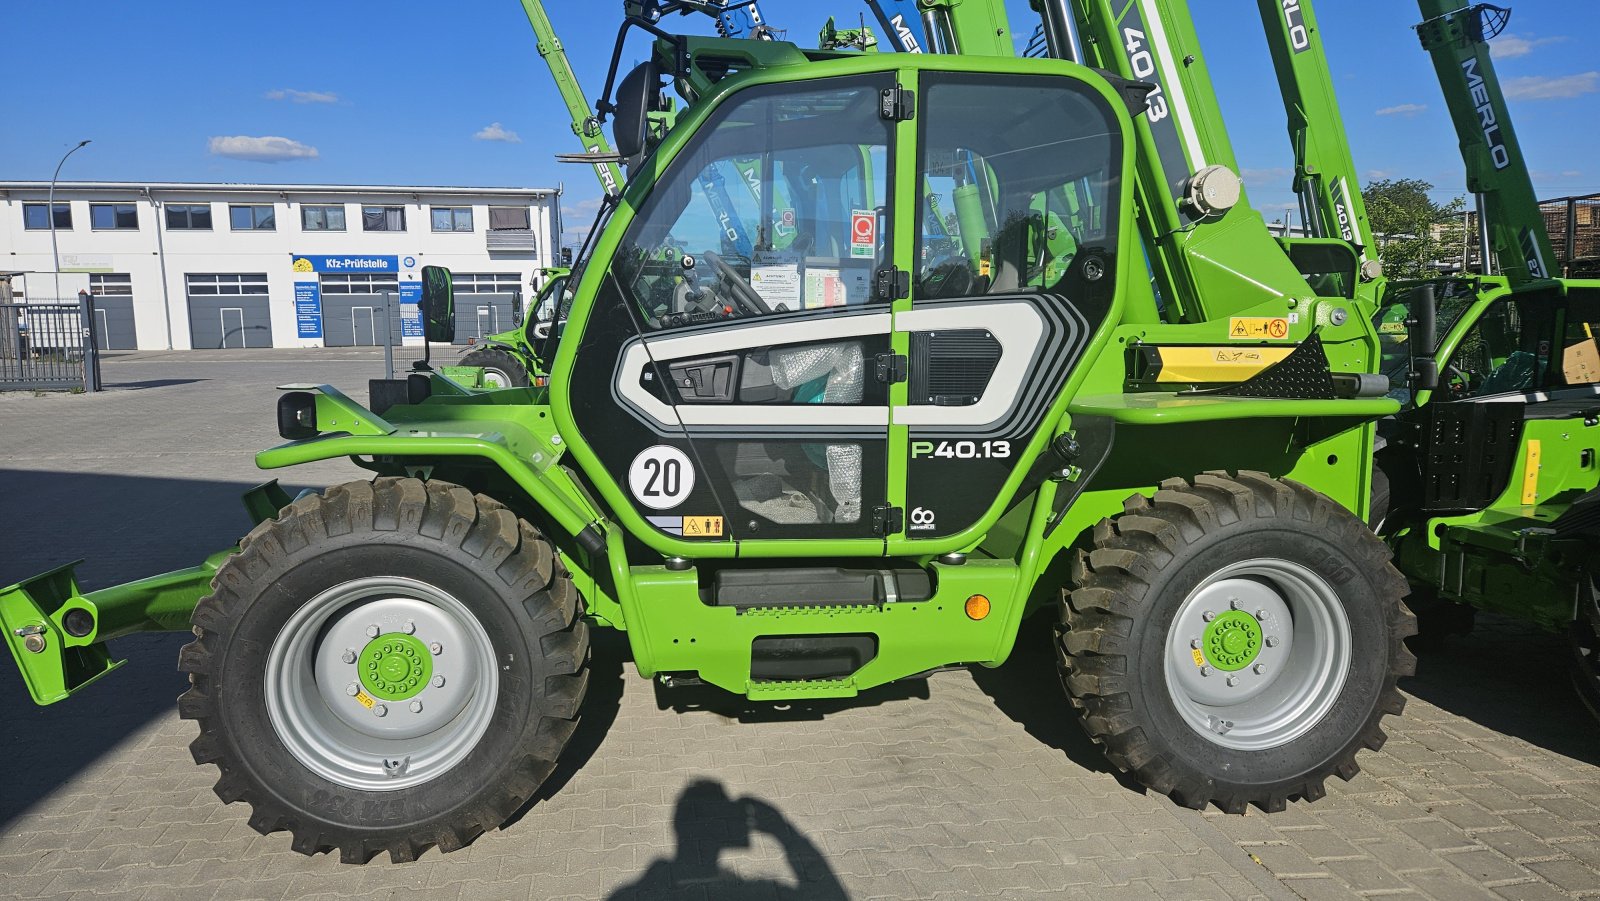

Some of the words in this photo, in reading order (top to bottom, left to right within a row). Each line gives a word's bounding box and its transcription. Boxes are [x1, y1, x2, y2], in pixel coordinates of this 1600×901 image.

[1124, 27, 1168, 122] 4013
[1461, 57, 1510, 169] MERLO
[705, 182, 738, 242] MERLO
[1336, 203, 1353, 241] 40.13
[326, 258, 388, 269] Kfz-Prüfstelle
[1527, 258, 1542, 278] 27
[643, 458, 681, 497] 20
